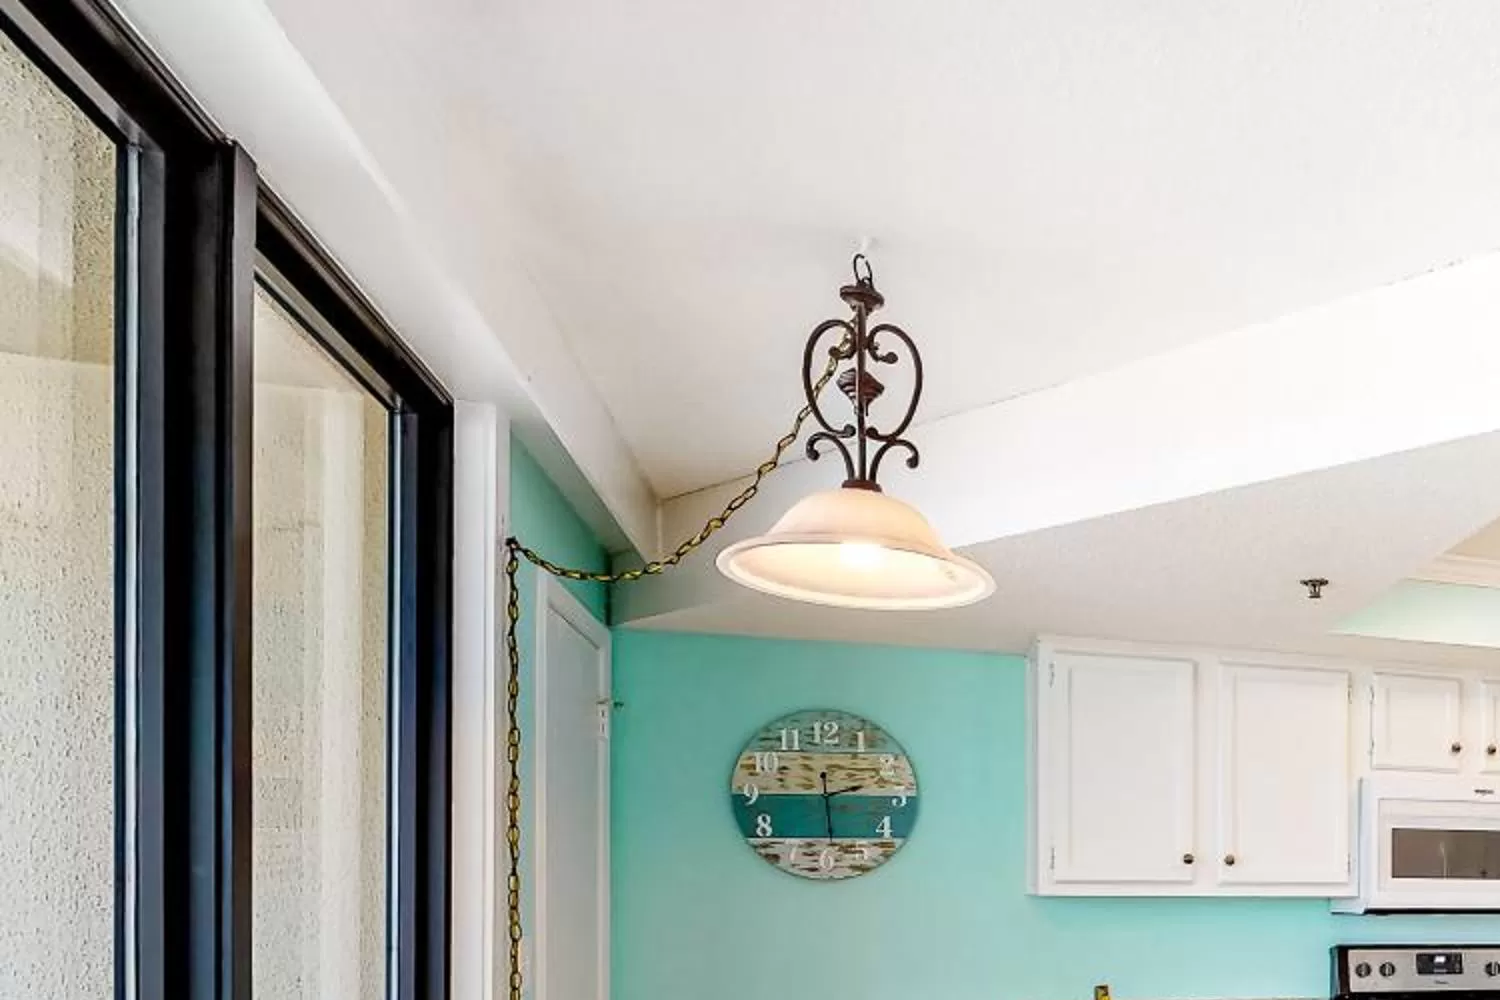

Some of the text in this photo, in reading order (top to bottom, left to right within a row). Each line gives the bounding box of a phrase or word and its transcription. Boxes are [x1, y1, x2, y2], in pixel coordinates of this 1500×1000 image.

[780, 728, 801, 751] 11
[811, 721, 839, 745] 12
[856, 731, 865, 752] 1
[753, 751, 779, 774] 10
[879, 754, 896, 776] 2
[743, 783, 760, 806] 9
[756, 813, 773, 837] 8
[875, 815, 894, 838] 4
[819, 847, 835, 871] 6
